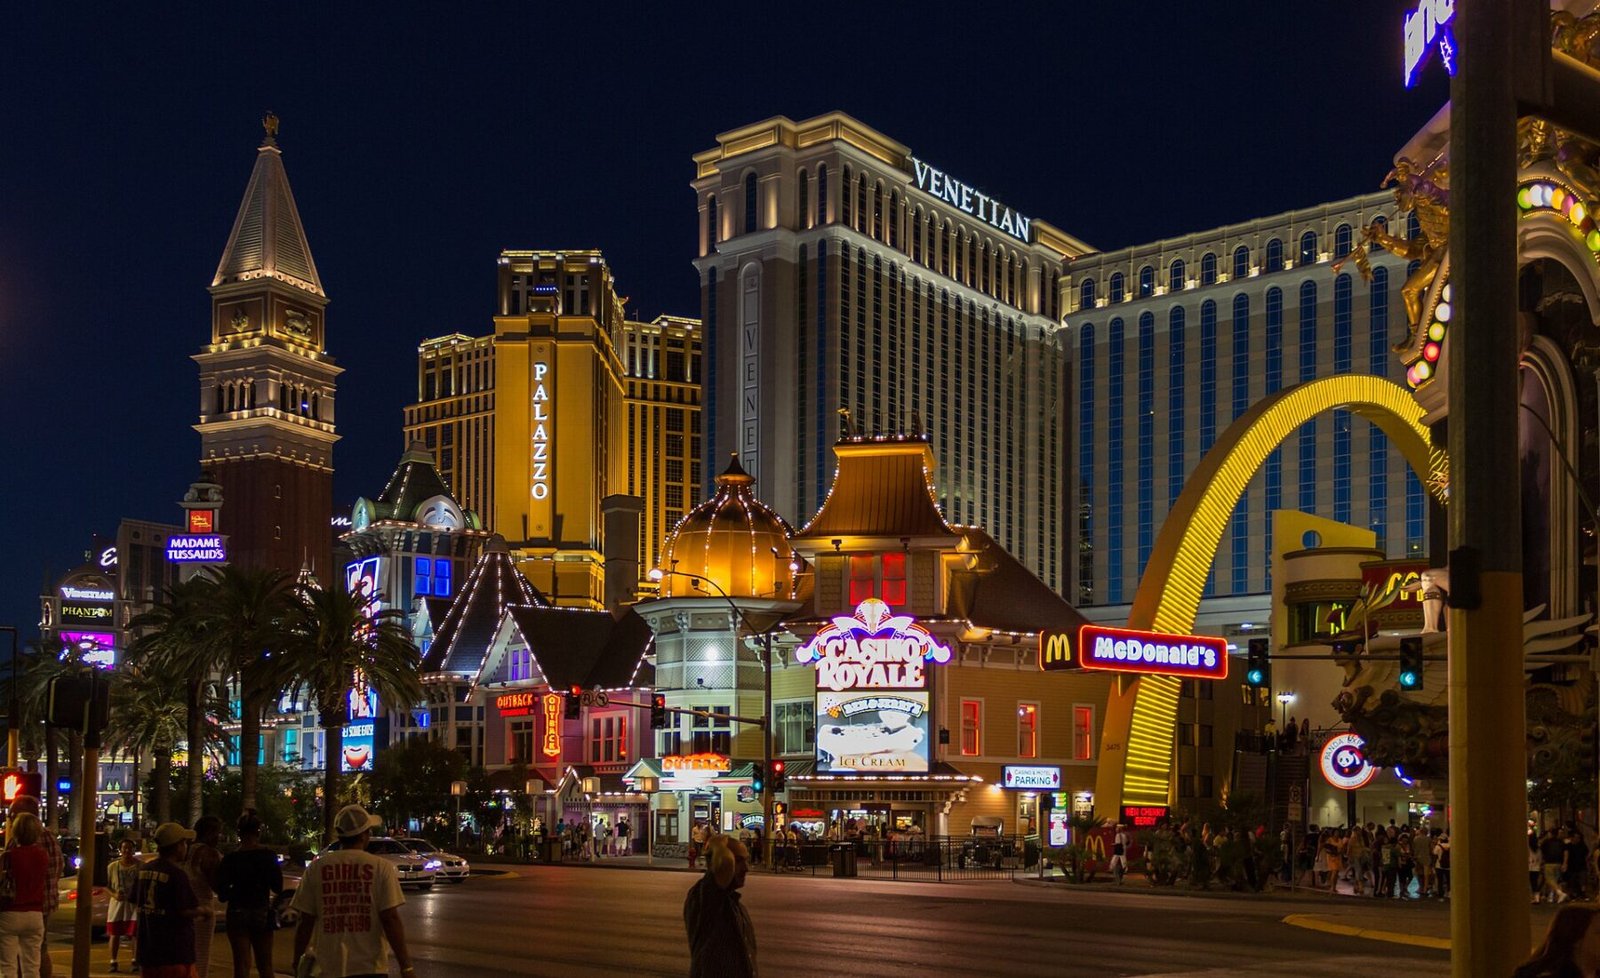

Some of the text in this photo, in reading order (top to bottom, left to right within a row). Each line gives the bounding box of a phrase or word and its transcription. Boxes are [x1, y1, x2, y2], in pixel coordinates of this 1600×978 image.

[911, 157, 1030, 243] VENETIAN
[531, 363, 548, 499] PALAZZO
[170, 538, 221, 548] MADAME
[167, 548, 224, 560] TUSSAUD'S
[62, 606, 113, 617] PHANTOM
[826, 639, 920, 662] CASINO
[1094, 637, 1216, 667] McDonald's
[815, 657, 925, 691] ROYALE
[497, 694, 534, 709] OUTBACK
[548, 697, 556, 750] OUTBACK
[1324, 738, 1344, 760] PANDA
[840, 755, 906, 767] ICE CREAM
[1015, 776, 1051, 785] PARKING
[322, 863, 373, 881] GIRLS
[322, 881, 372, 894] DIRECT
